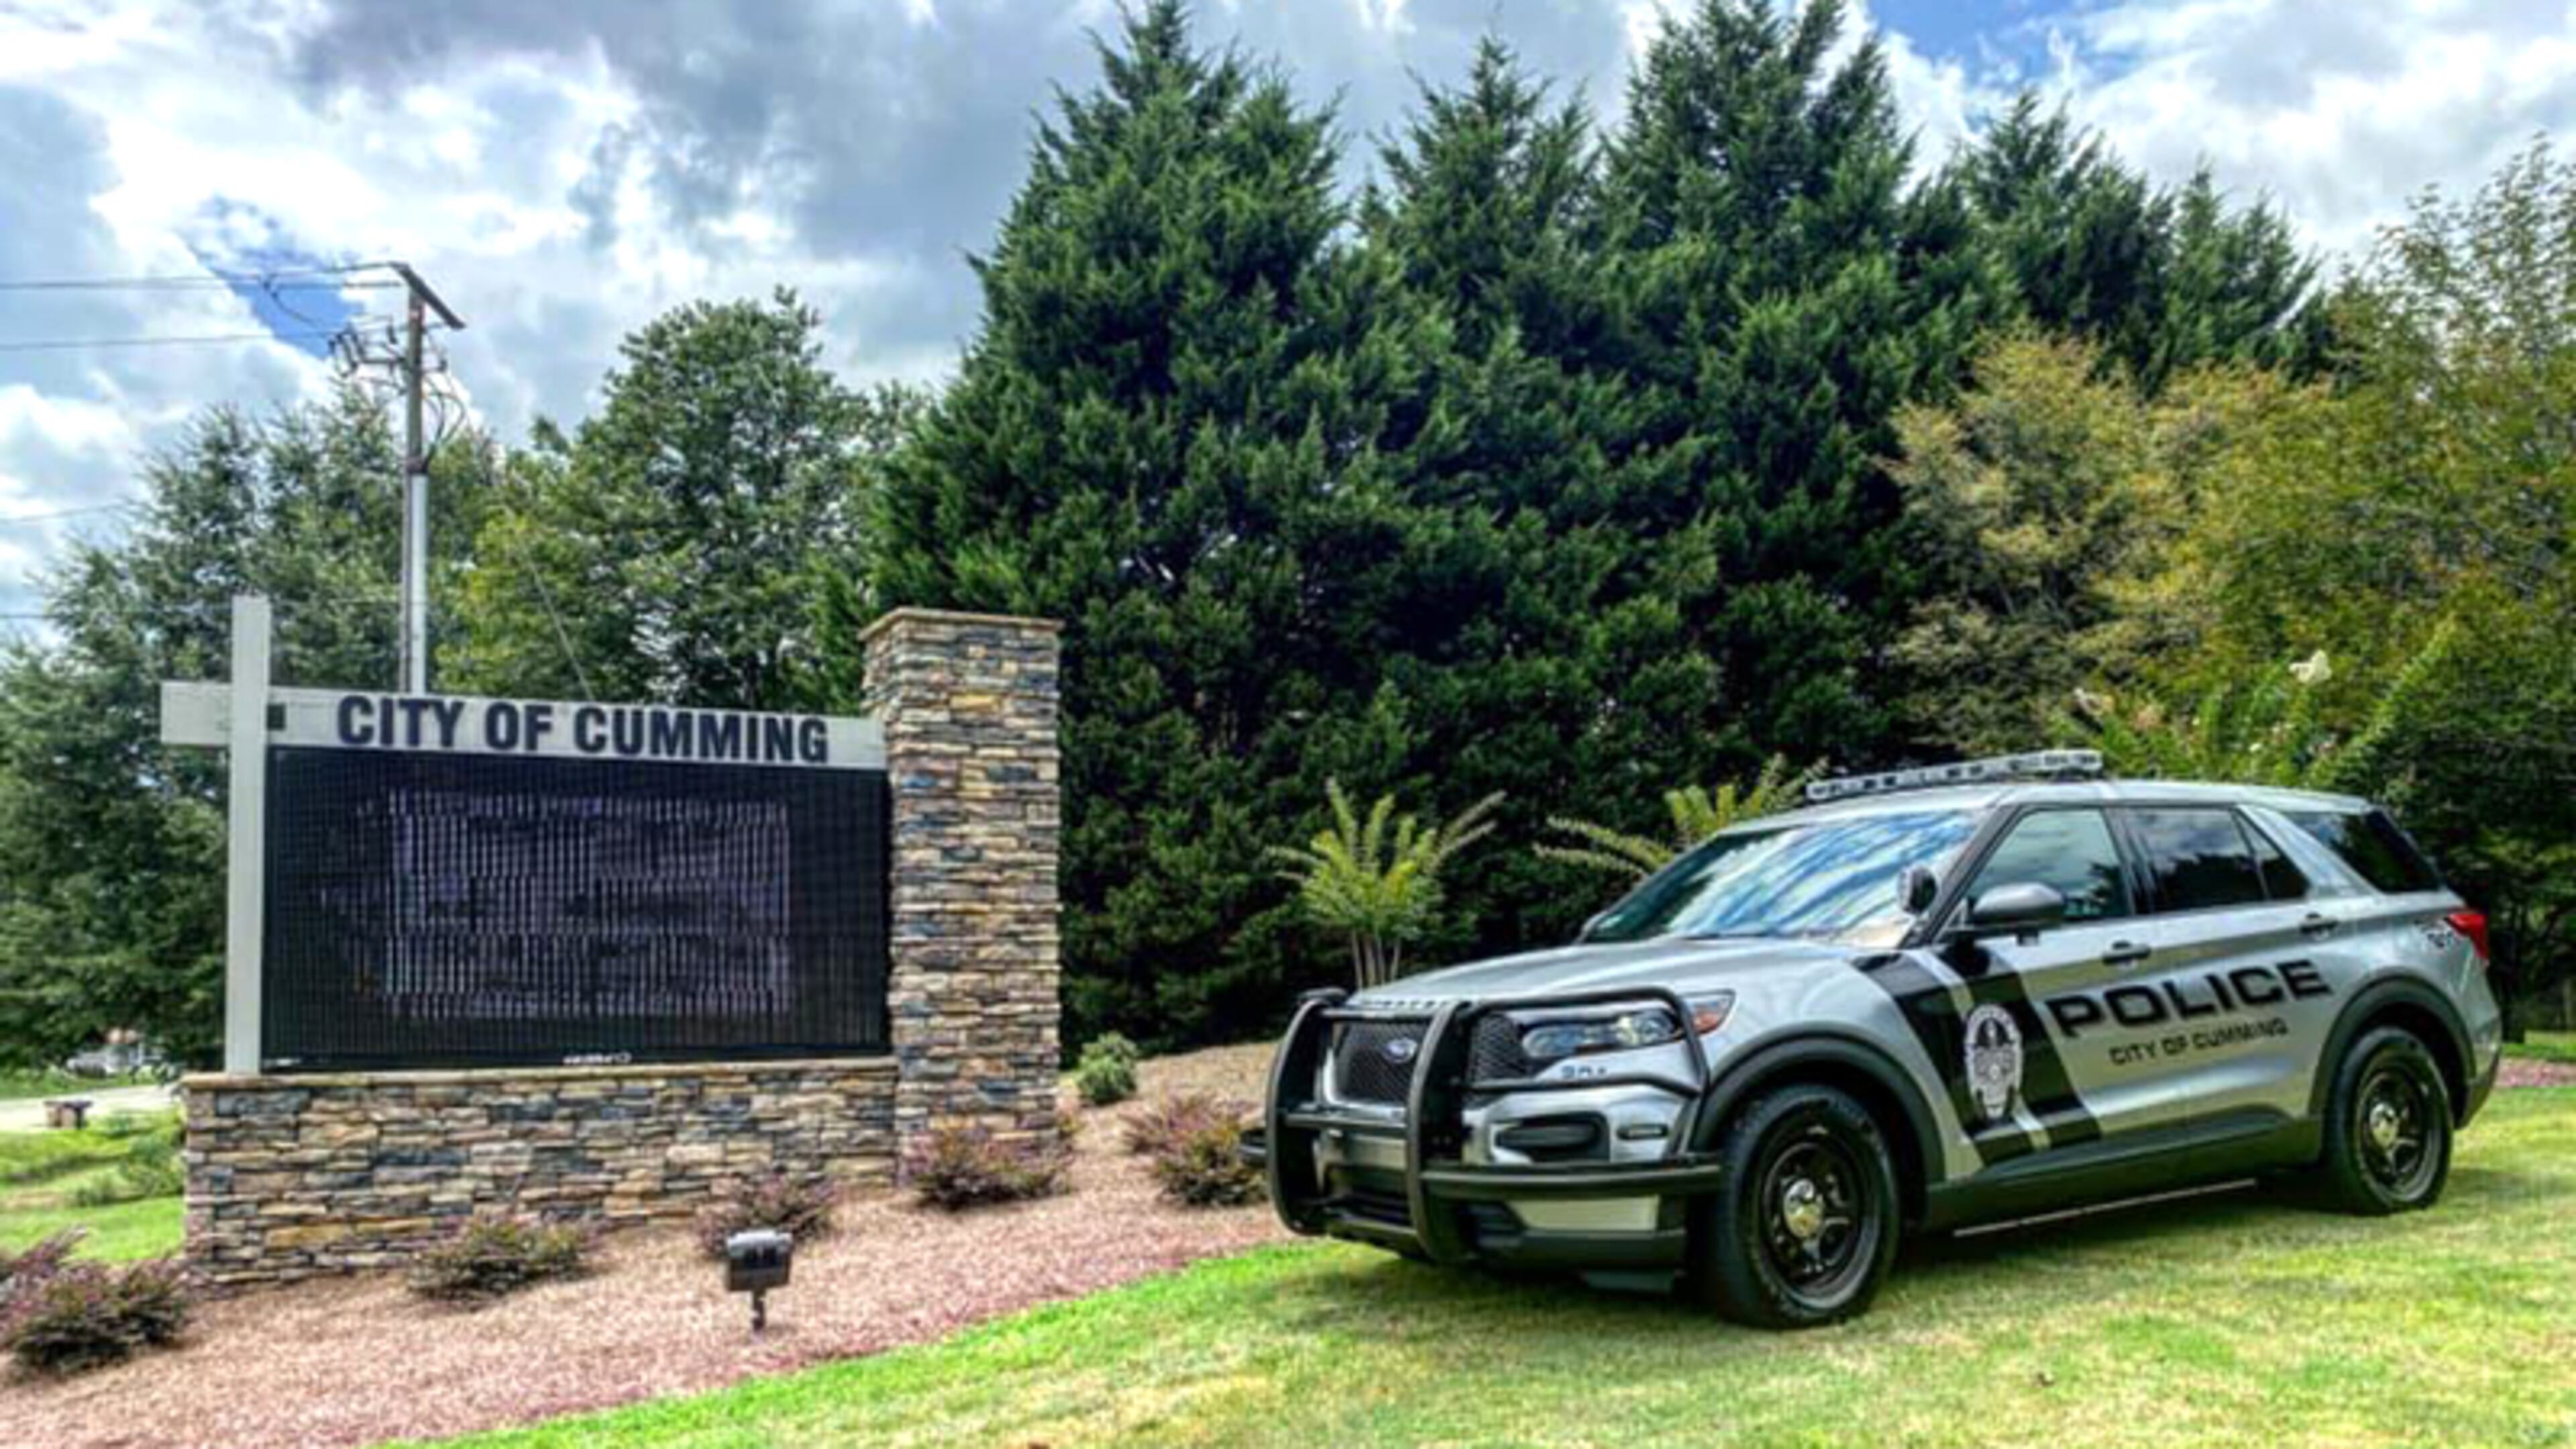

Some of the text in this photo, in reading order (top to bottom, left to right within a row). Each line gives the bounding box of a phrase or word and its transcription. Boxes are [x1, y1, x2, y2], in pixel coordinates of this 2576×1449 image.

[337, 694, 830, 764] CITY OF CUMMING
[2044, 959, 2333, 1038] POLICE
[2108, 1017, 2290, 1065] CITY OF CUMMING
